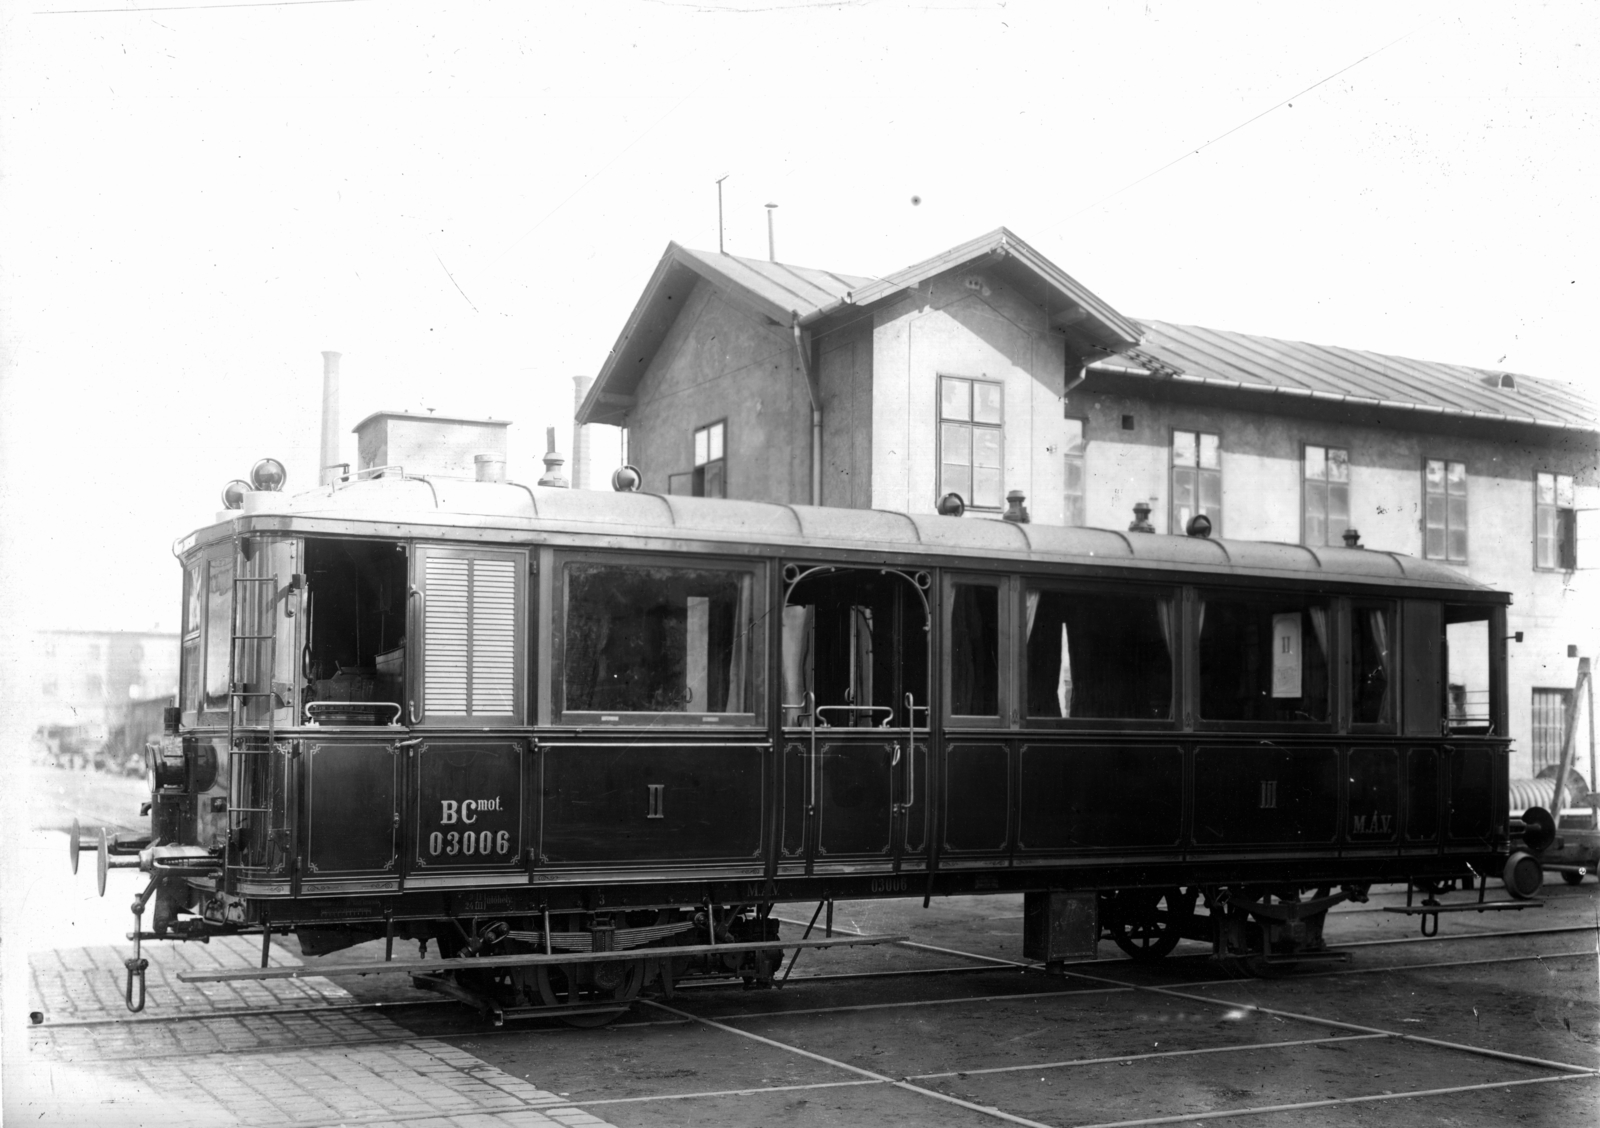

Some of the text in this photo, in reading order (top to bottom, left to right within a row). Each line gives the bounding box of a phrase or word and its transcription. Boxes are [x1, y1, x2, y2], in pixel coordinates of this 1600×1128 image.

[647, 784, 664, 818] II
[1260, 780, 1277, 809] III
[429, 830, 510, 856] 03006
[871, 877, 907, 893] 03006
